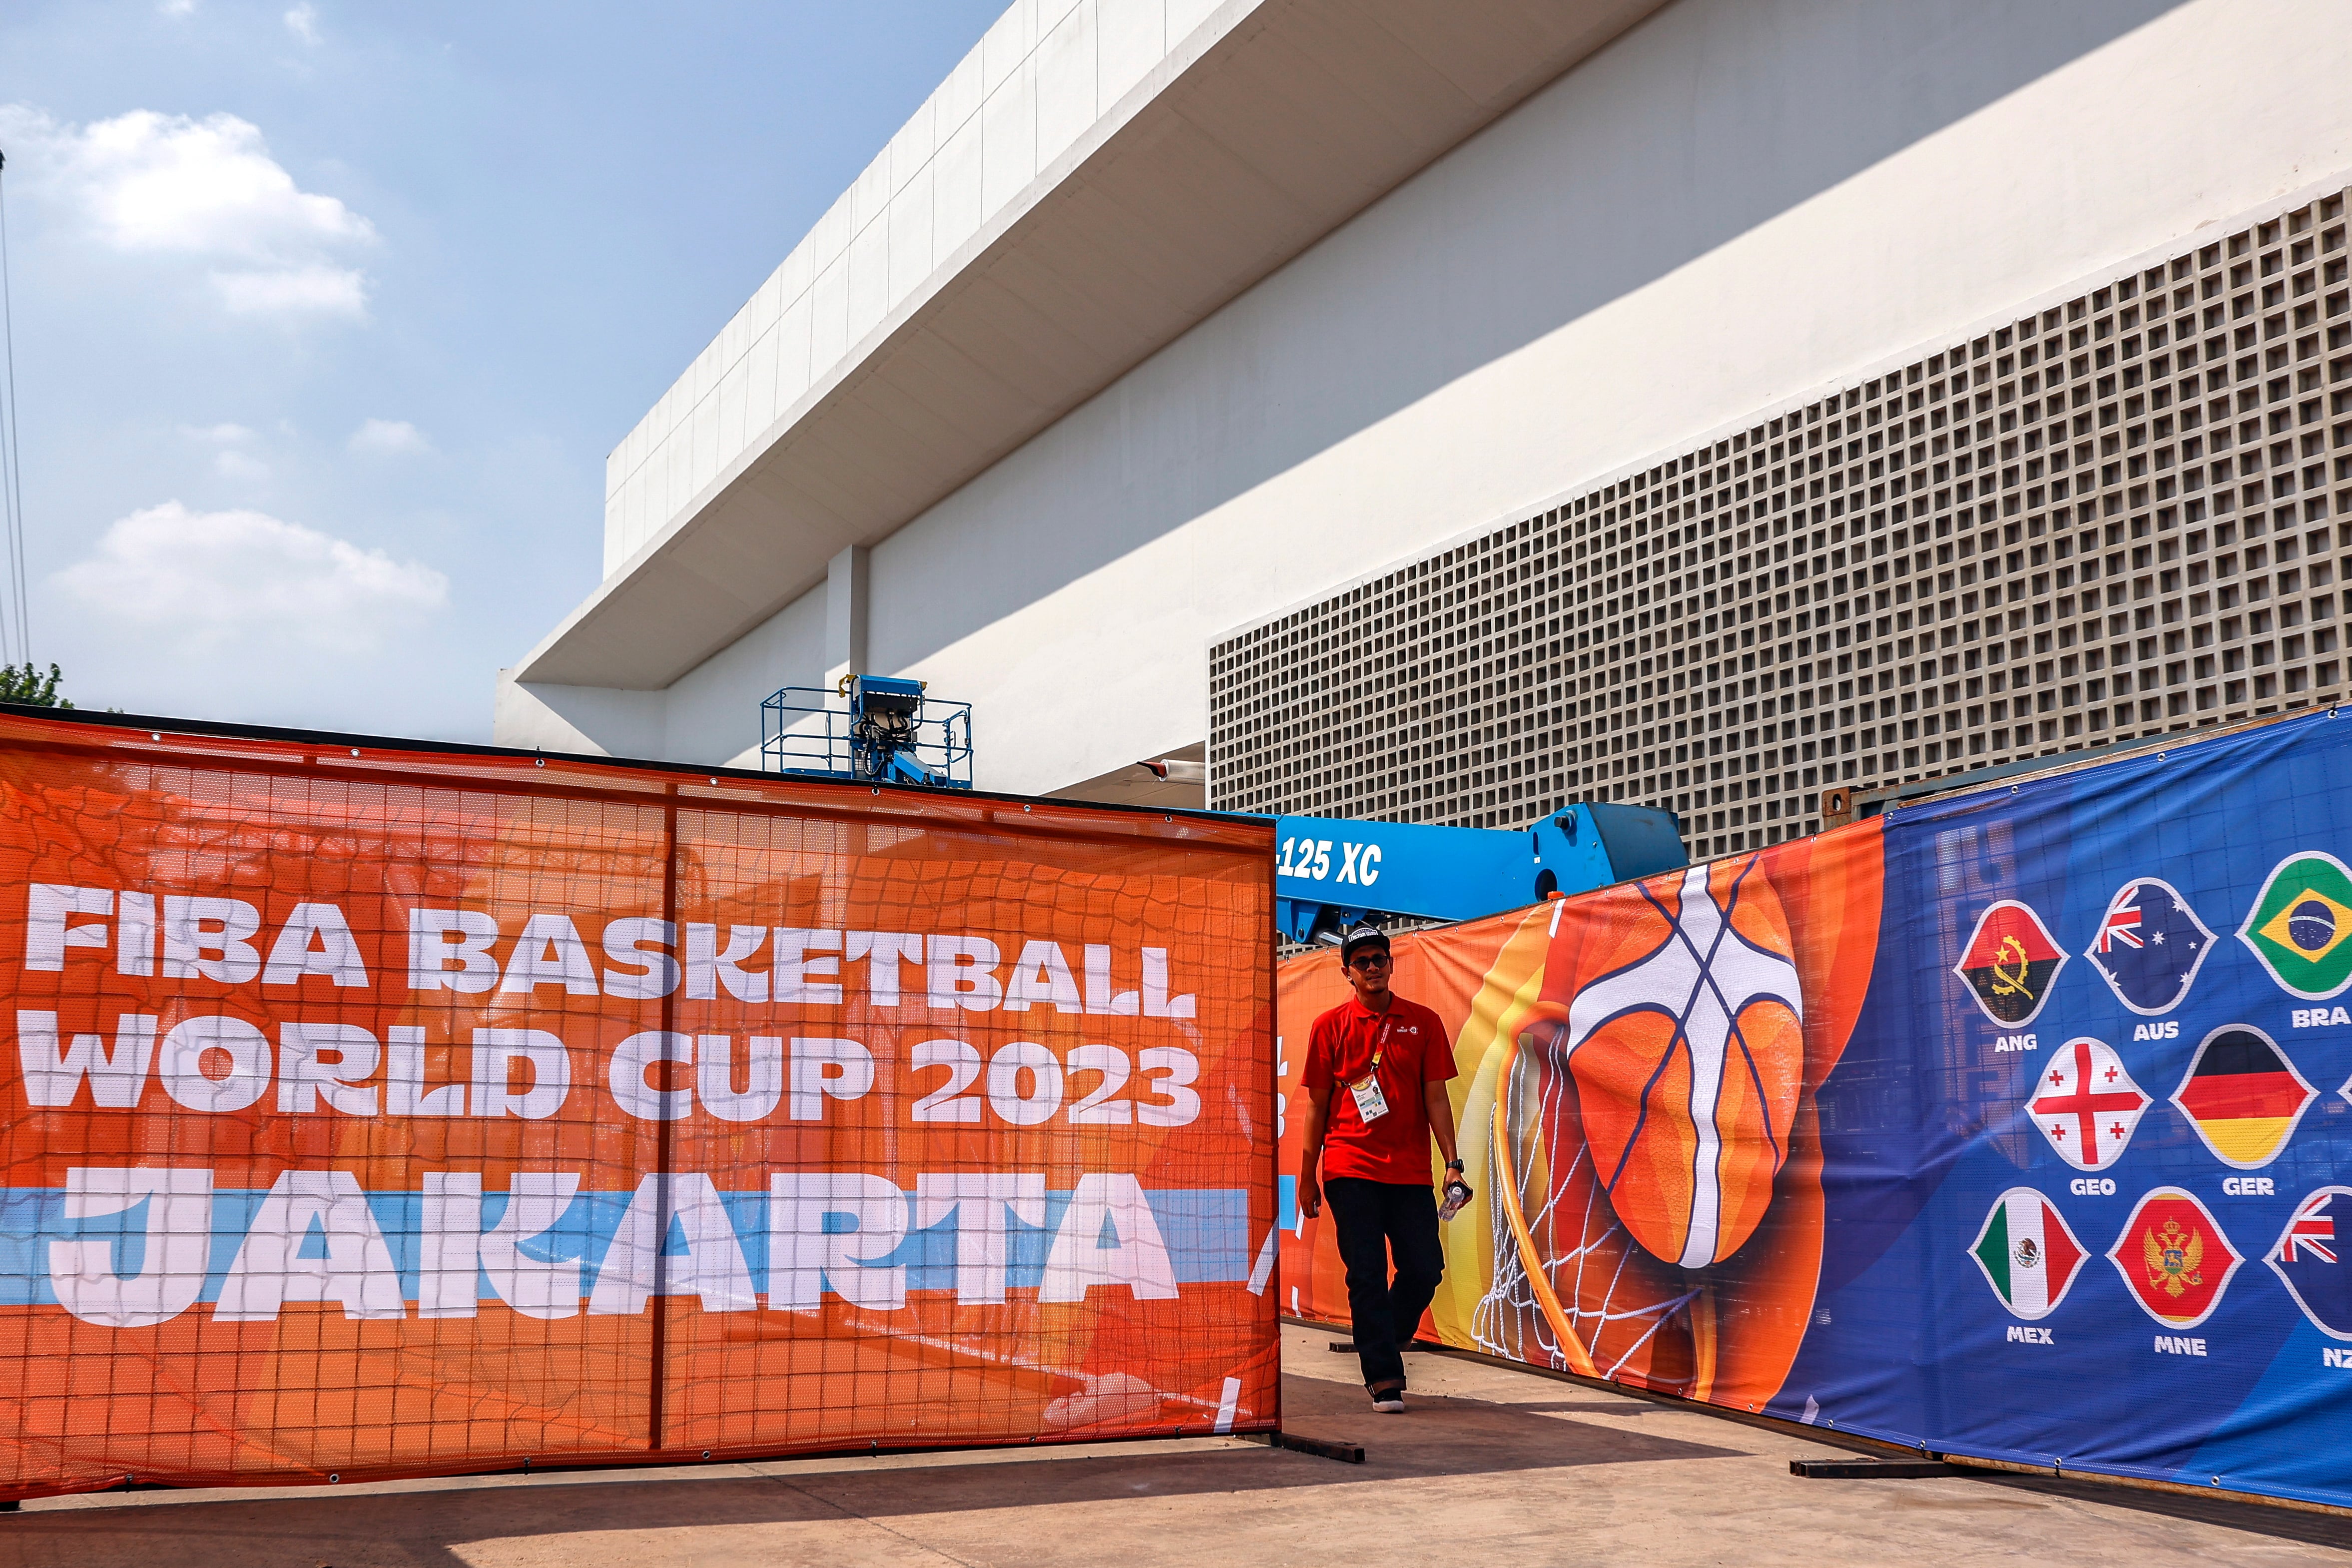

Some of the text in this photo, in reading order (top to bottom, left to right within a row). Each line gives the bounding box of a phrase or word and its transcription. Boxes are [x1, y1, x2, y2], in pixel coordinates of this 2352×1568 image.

[1335, 842, 1382, 886] XC
[25, 883, 1196, 1018] FIBA BASKETBALL
[2292, 1006, 2351, 1028] BRA
[2133, 1021, 2179, 1042] AUS
[1994, 1033, 2037, 1053] ANG
[16, 1010, 571, 1119] WORLD
[609, 1031, 874, 1121] CUP
[911, 1039, 1200, 1126] 2023
[2070, 1177, 2116, 1196] GEO
[2222, 1177, 2275, 1196] GER
[49, 1167, 1179, 1327] JAKARTA
[2006, 1326, 2055, 1345] MEX
[2154, 1335, 2207, 1357] MNE
